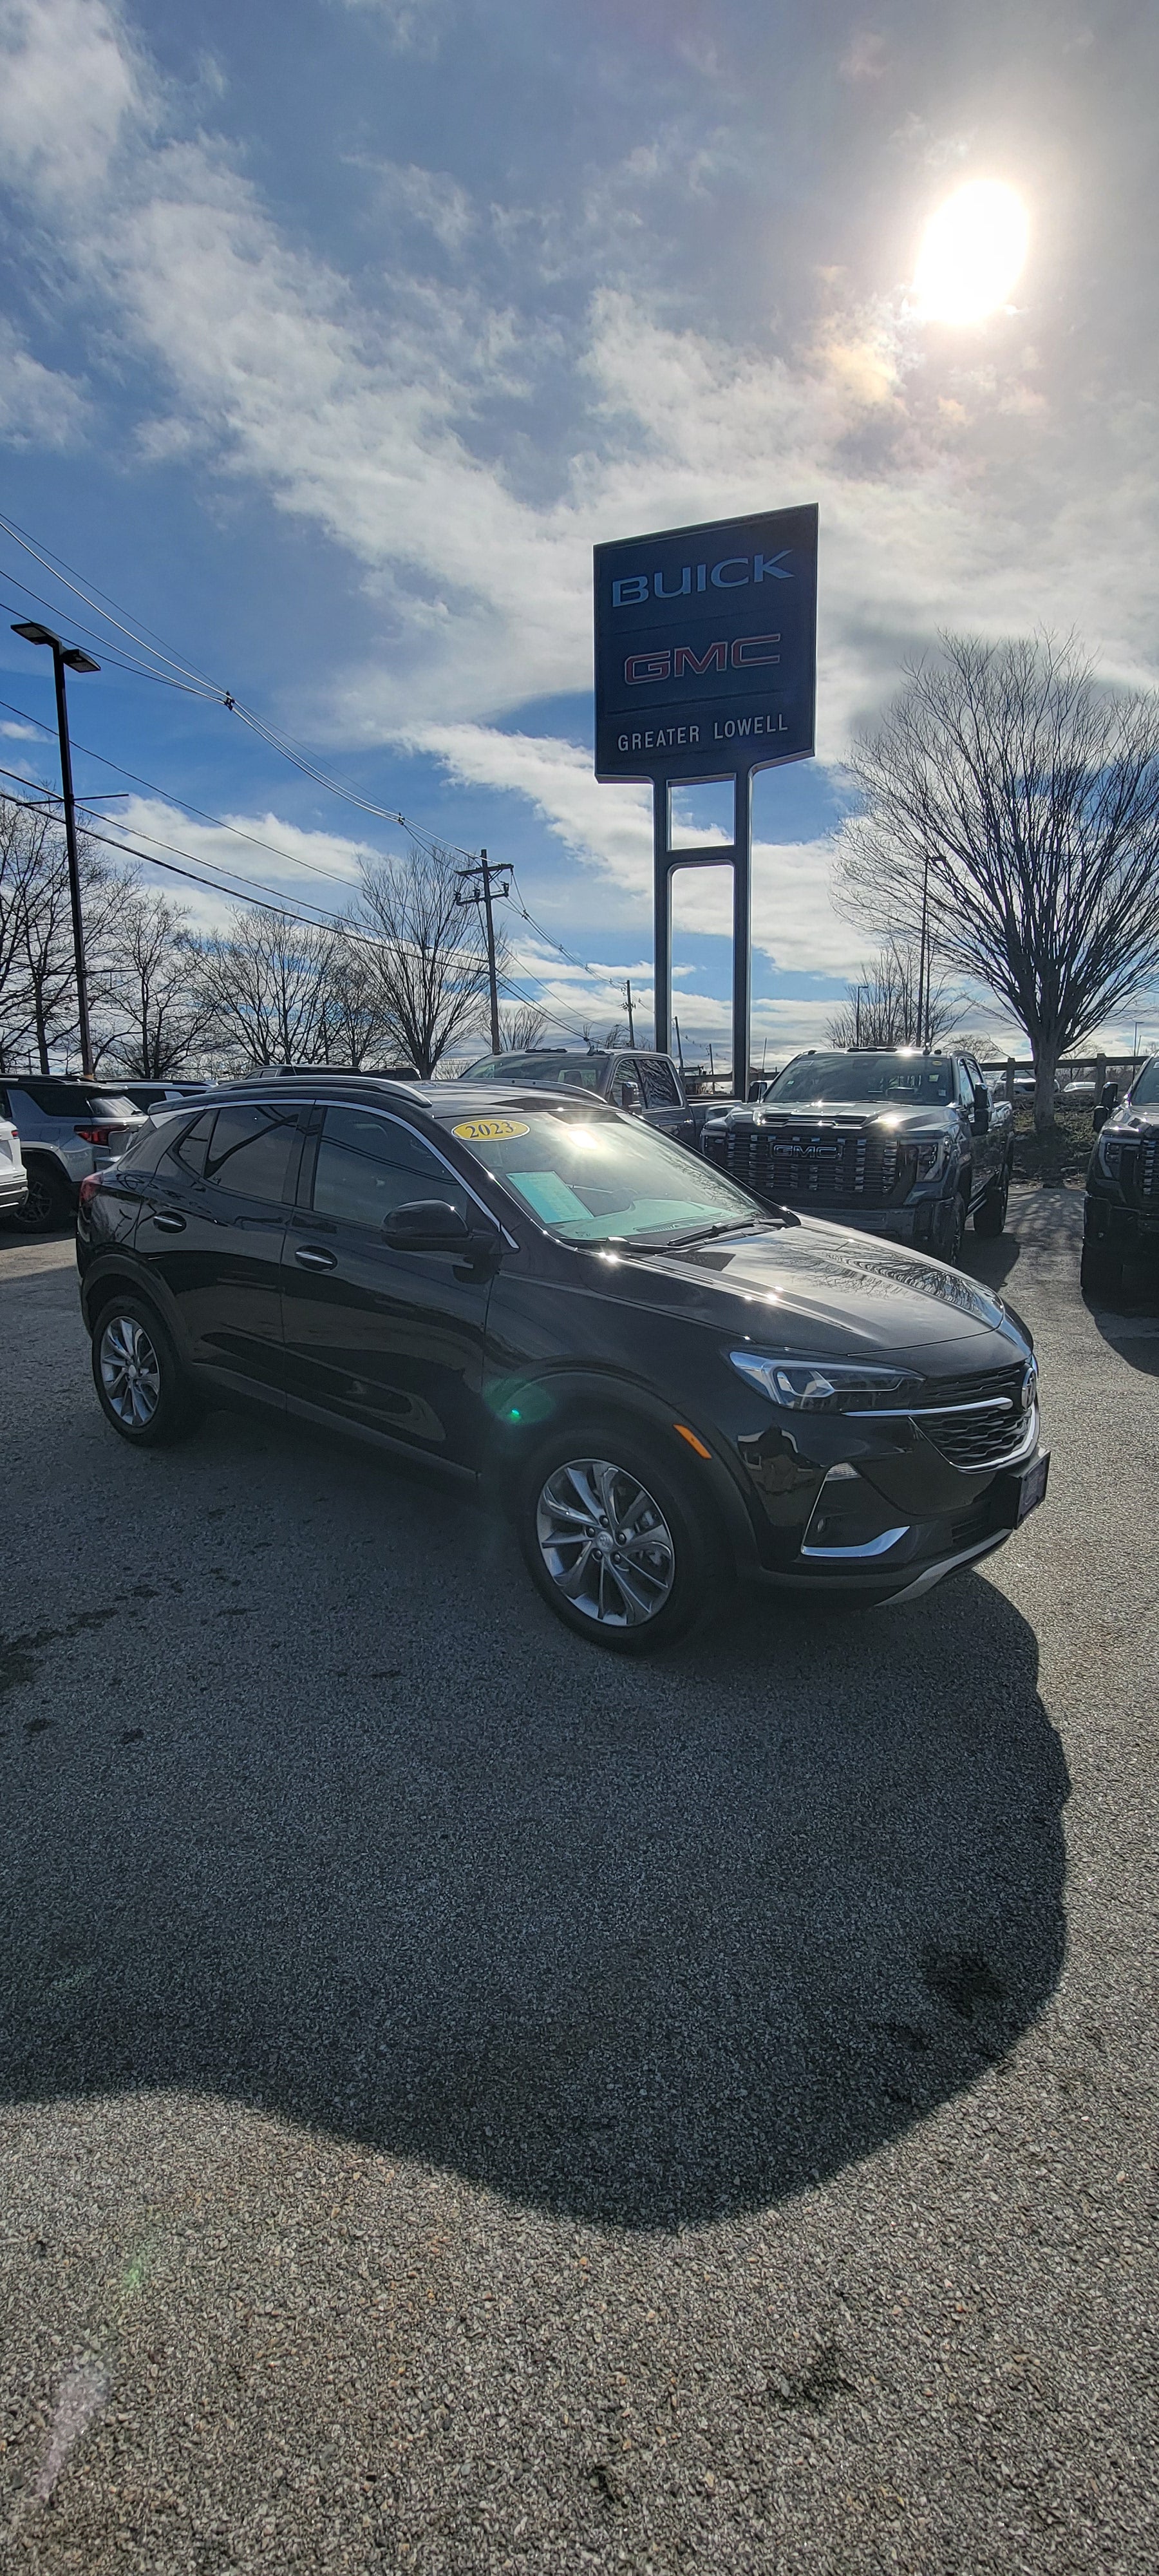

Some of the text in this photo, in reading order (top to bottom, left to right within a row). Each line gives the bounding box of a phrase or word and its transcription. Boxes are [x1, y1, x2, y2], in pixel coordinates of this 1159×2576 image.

[612, 549, 795, 607] BUICK
[624, 633, 781, 685] GMC
[617, 714, 788, 752] GREATER LOWELL
[465, 1122, 514, 1139] 2023
[773, 1144, 836, 1159] GMC
